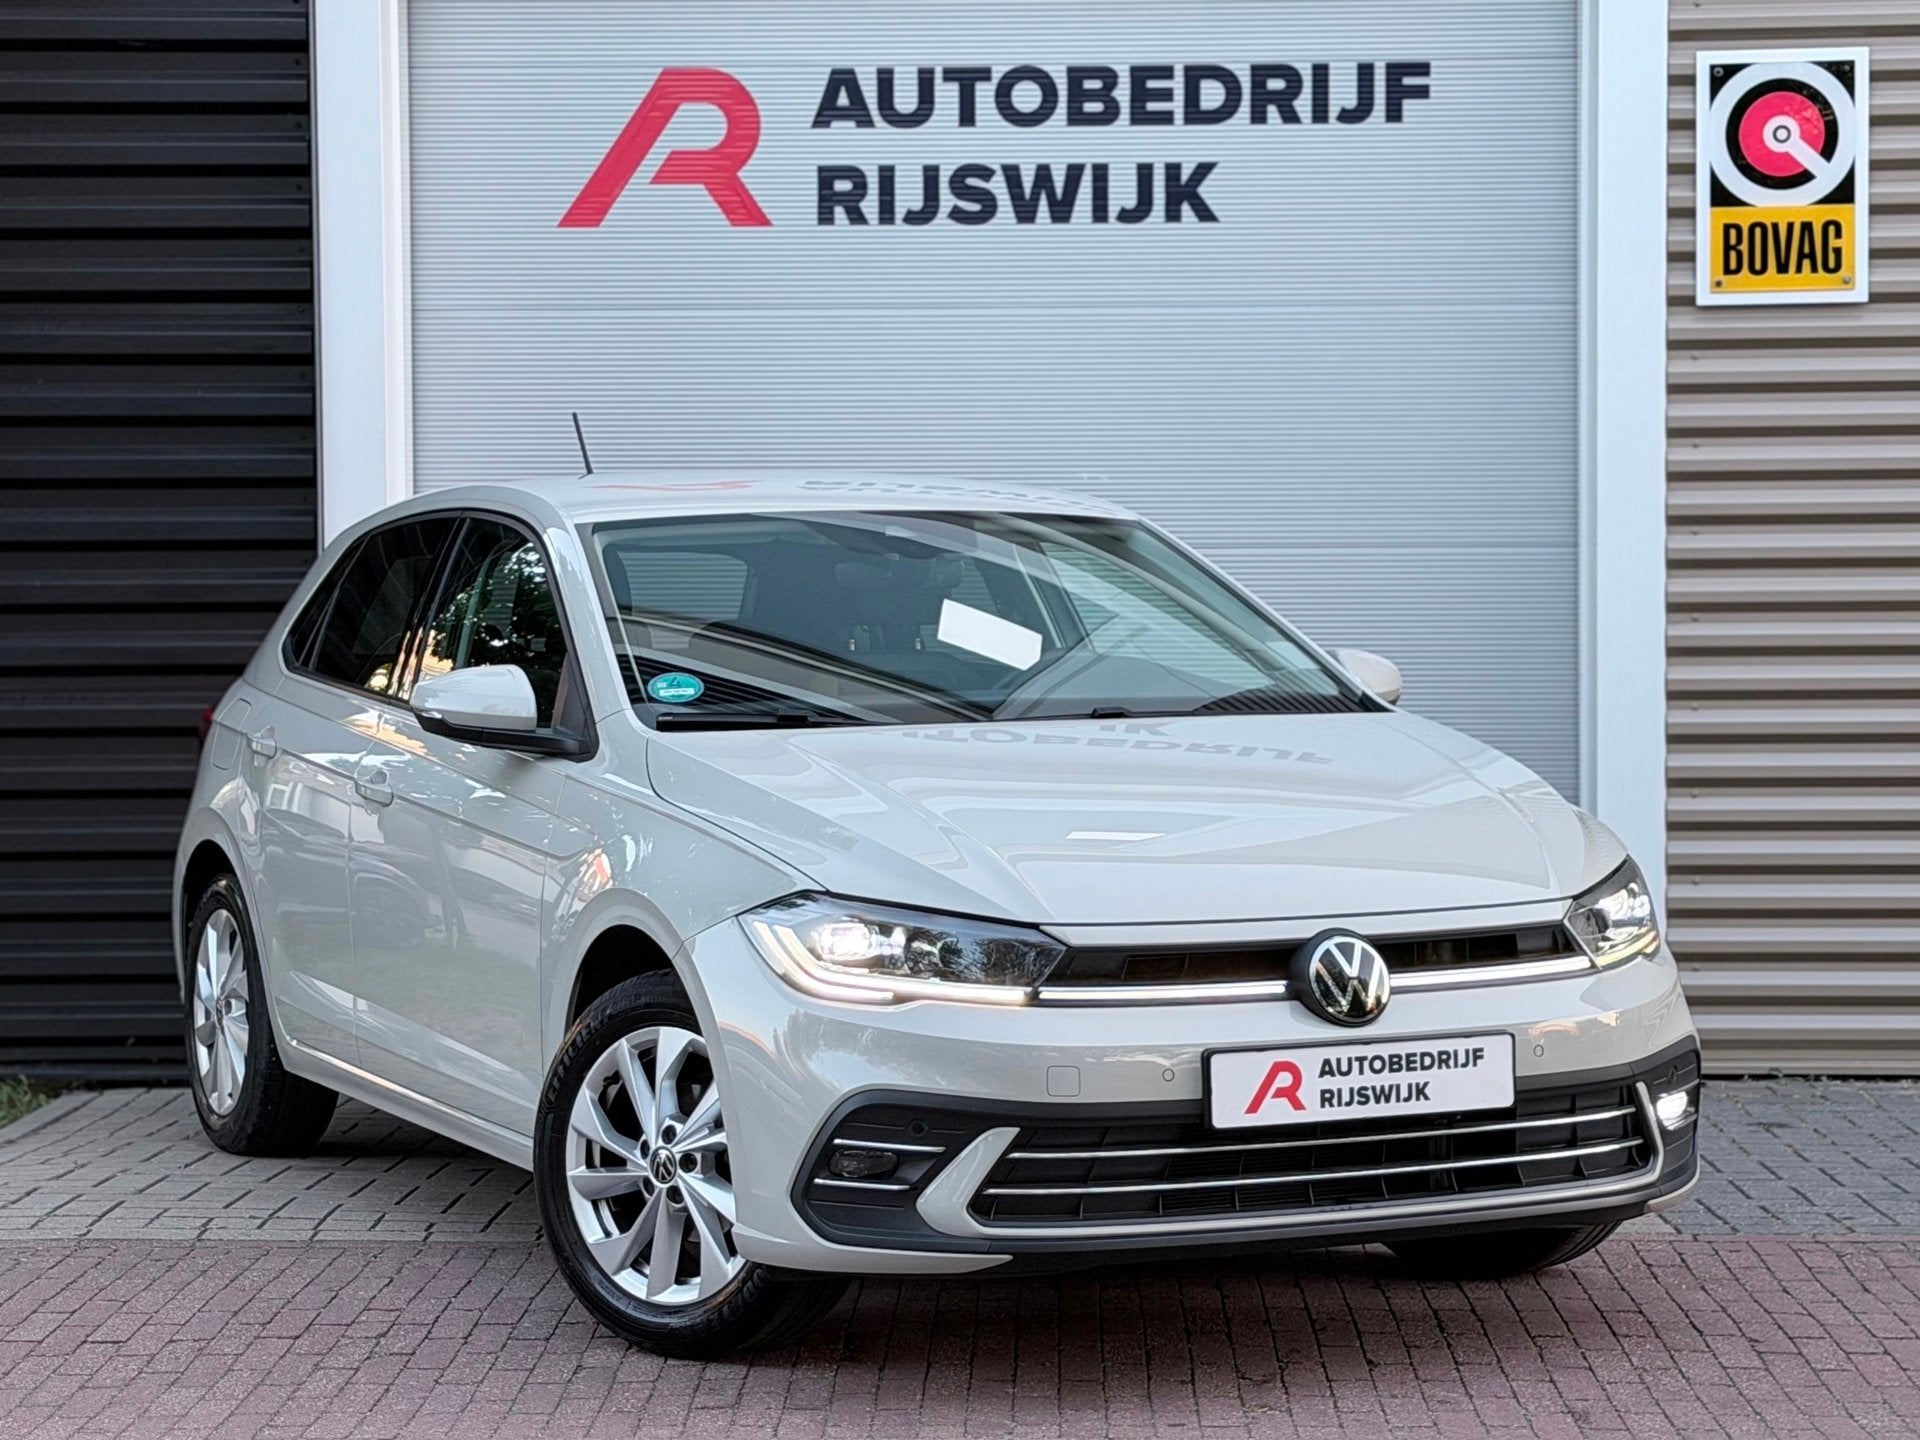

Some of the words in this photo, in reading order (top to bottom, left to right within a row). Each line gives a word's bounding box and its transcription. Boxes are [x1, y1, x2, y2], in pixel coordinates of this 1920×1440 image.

[812, 61, 1431, 129] AUTOBEDRIJF
[816, 161, 1221, 226] RIJSWIJK
[1722, 219, 1843, 276] BOVAG
[1318, 1047, 1485, 1079] AUTOBEDRIJF
[1320, 1081, 1431, 1109] RIJSWIJK
